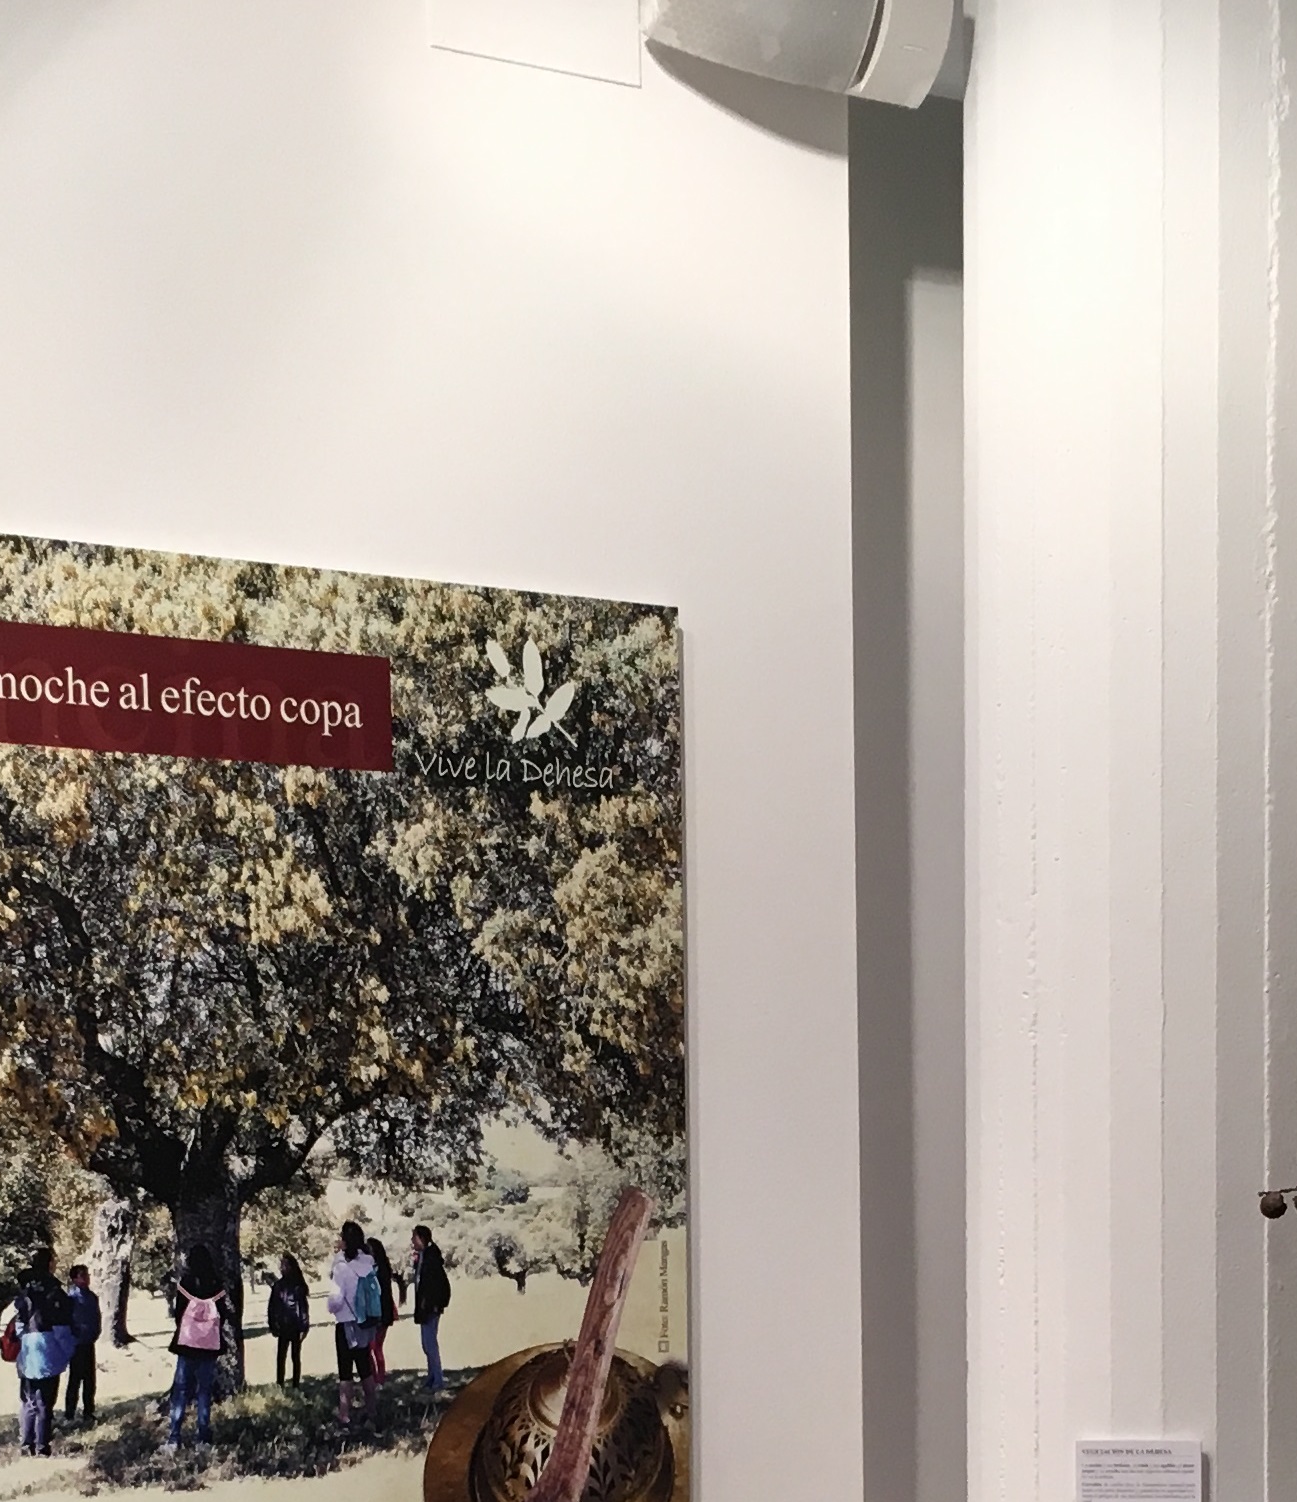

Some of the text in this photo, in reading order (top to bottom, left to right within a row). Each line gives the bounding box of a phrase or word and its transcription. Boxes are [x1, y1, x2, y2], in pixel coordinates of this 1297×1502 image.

[118, 672, 153, 712] al
[160, 676, 271, 721] efecto
[279, 697, 364, 737] copa
[414, 751, 614, 789] Vive la Dehesa
